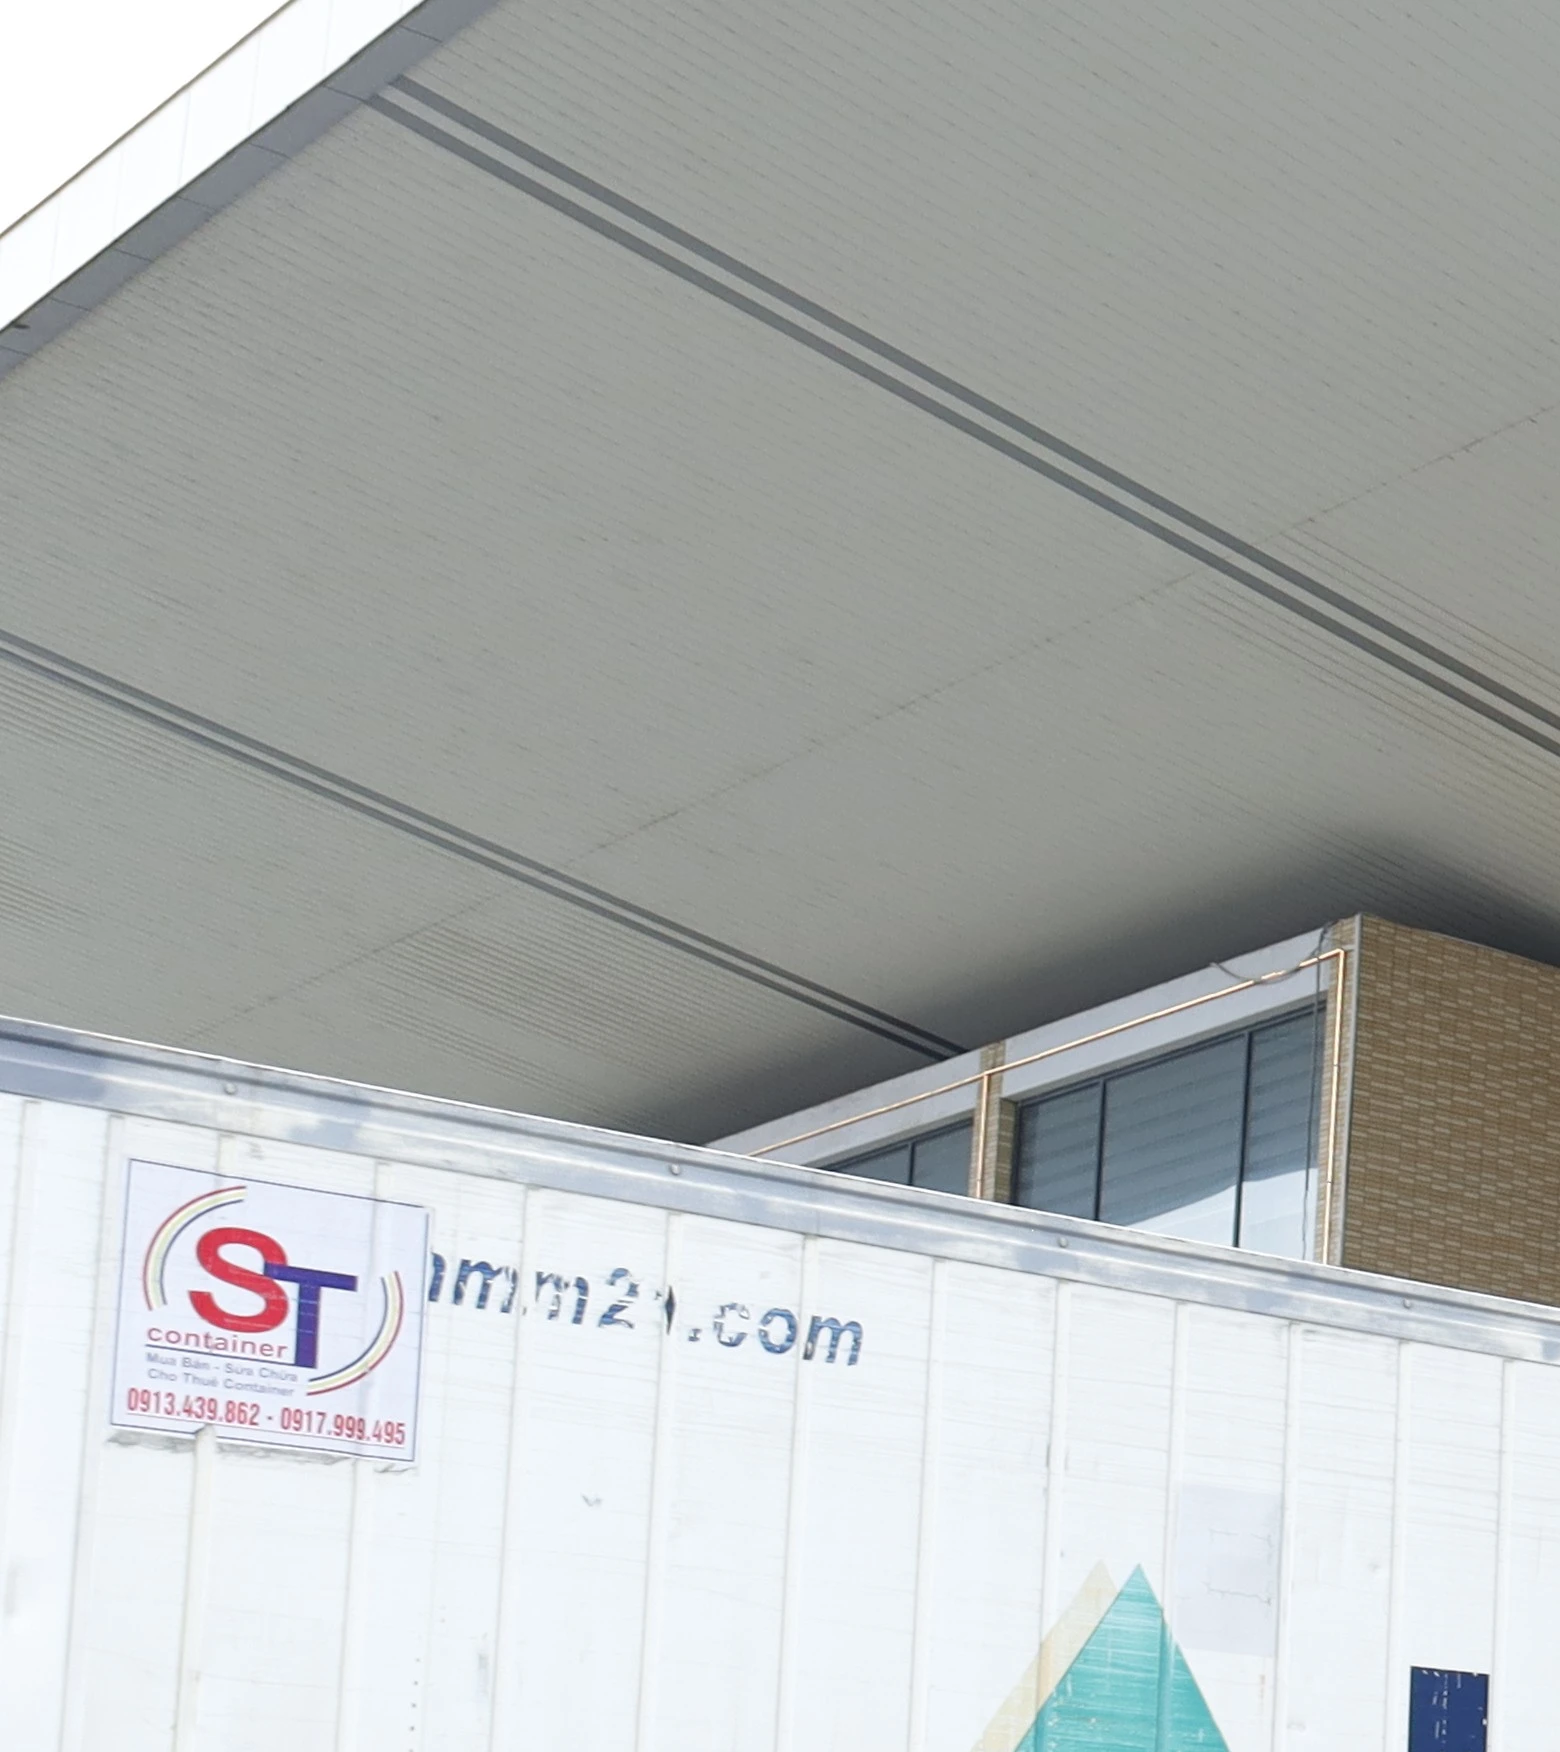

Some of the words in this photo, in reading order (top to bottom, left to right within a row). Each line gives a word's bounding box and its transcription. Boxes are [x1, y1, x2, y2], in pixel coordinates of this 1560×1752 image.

[188, 1227, 358, 1369] ST
[147, 1327, 288, 1358] container
[146, 1352, 177, 1366] Mua
[147, 1368, 177, 1381] Cho
[223, 1378, 295, 1396] Container
[127, 1387, 260, 1426] 0913.439.862
[280, 1407, 406, 1446] 0917.999.495
